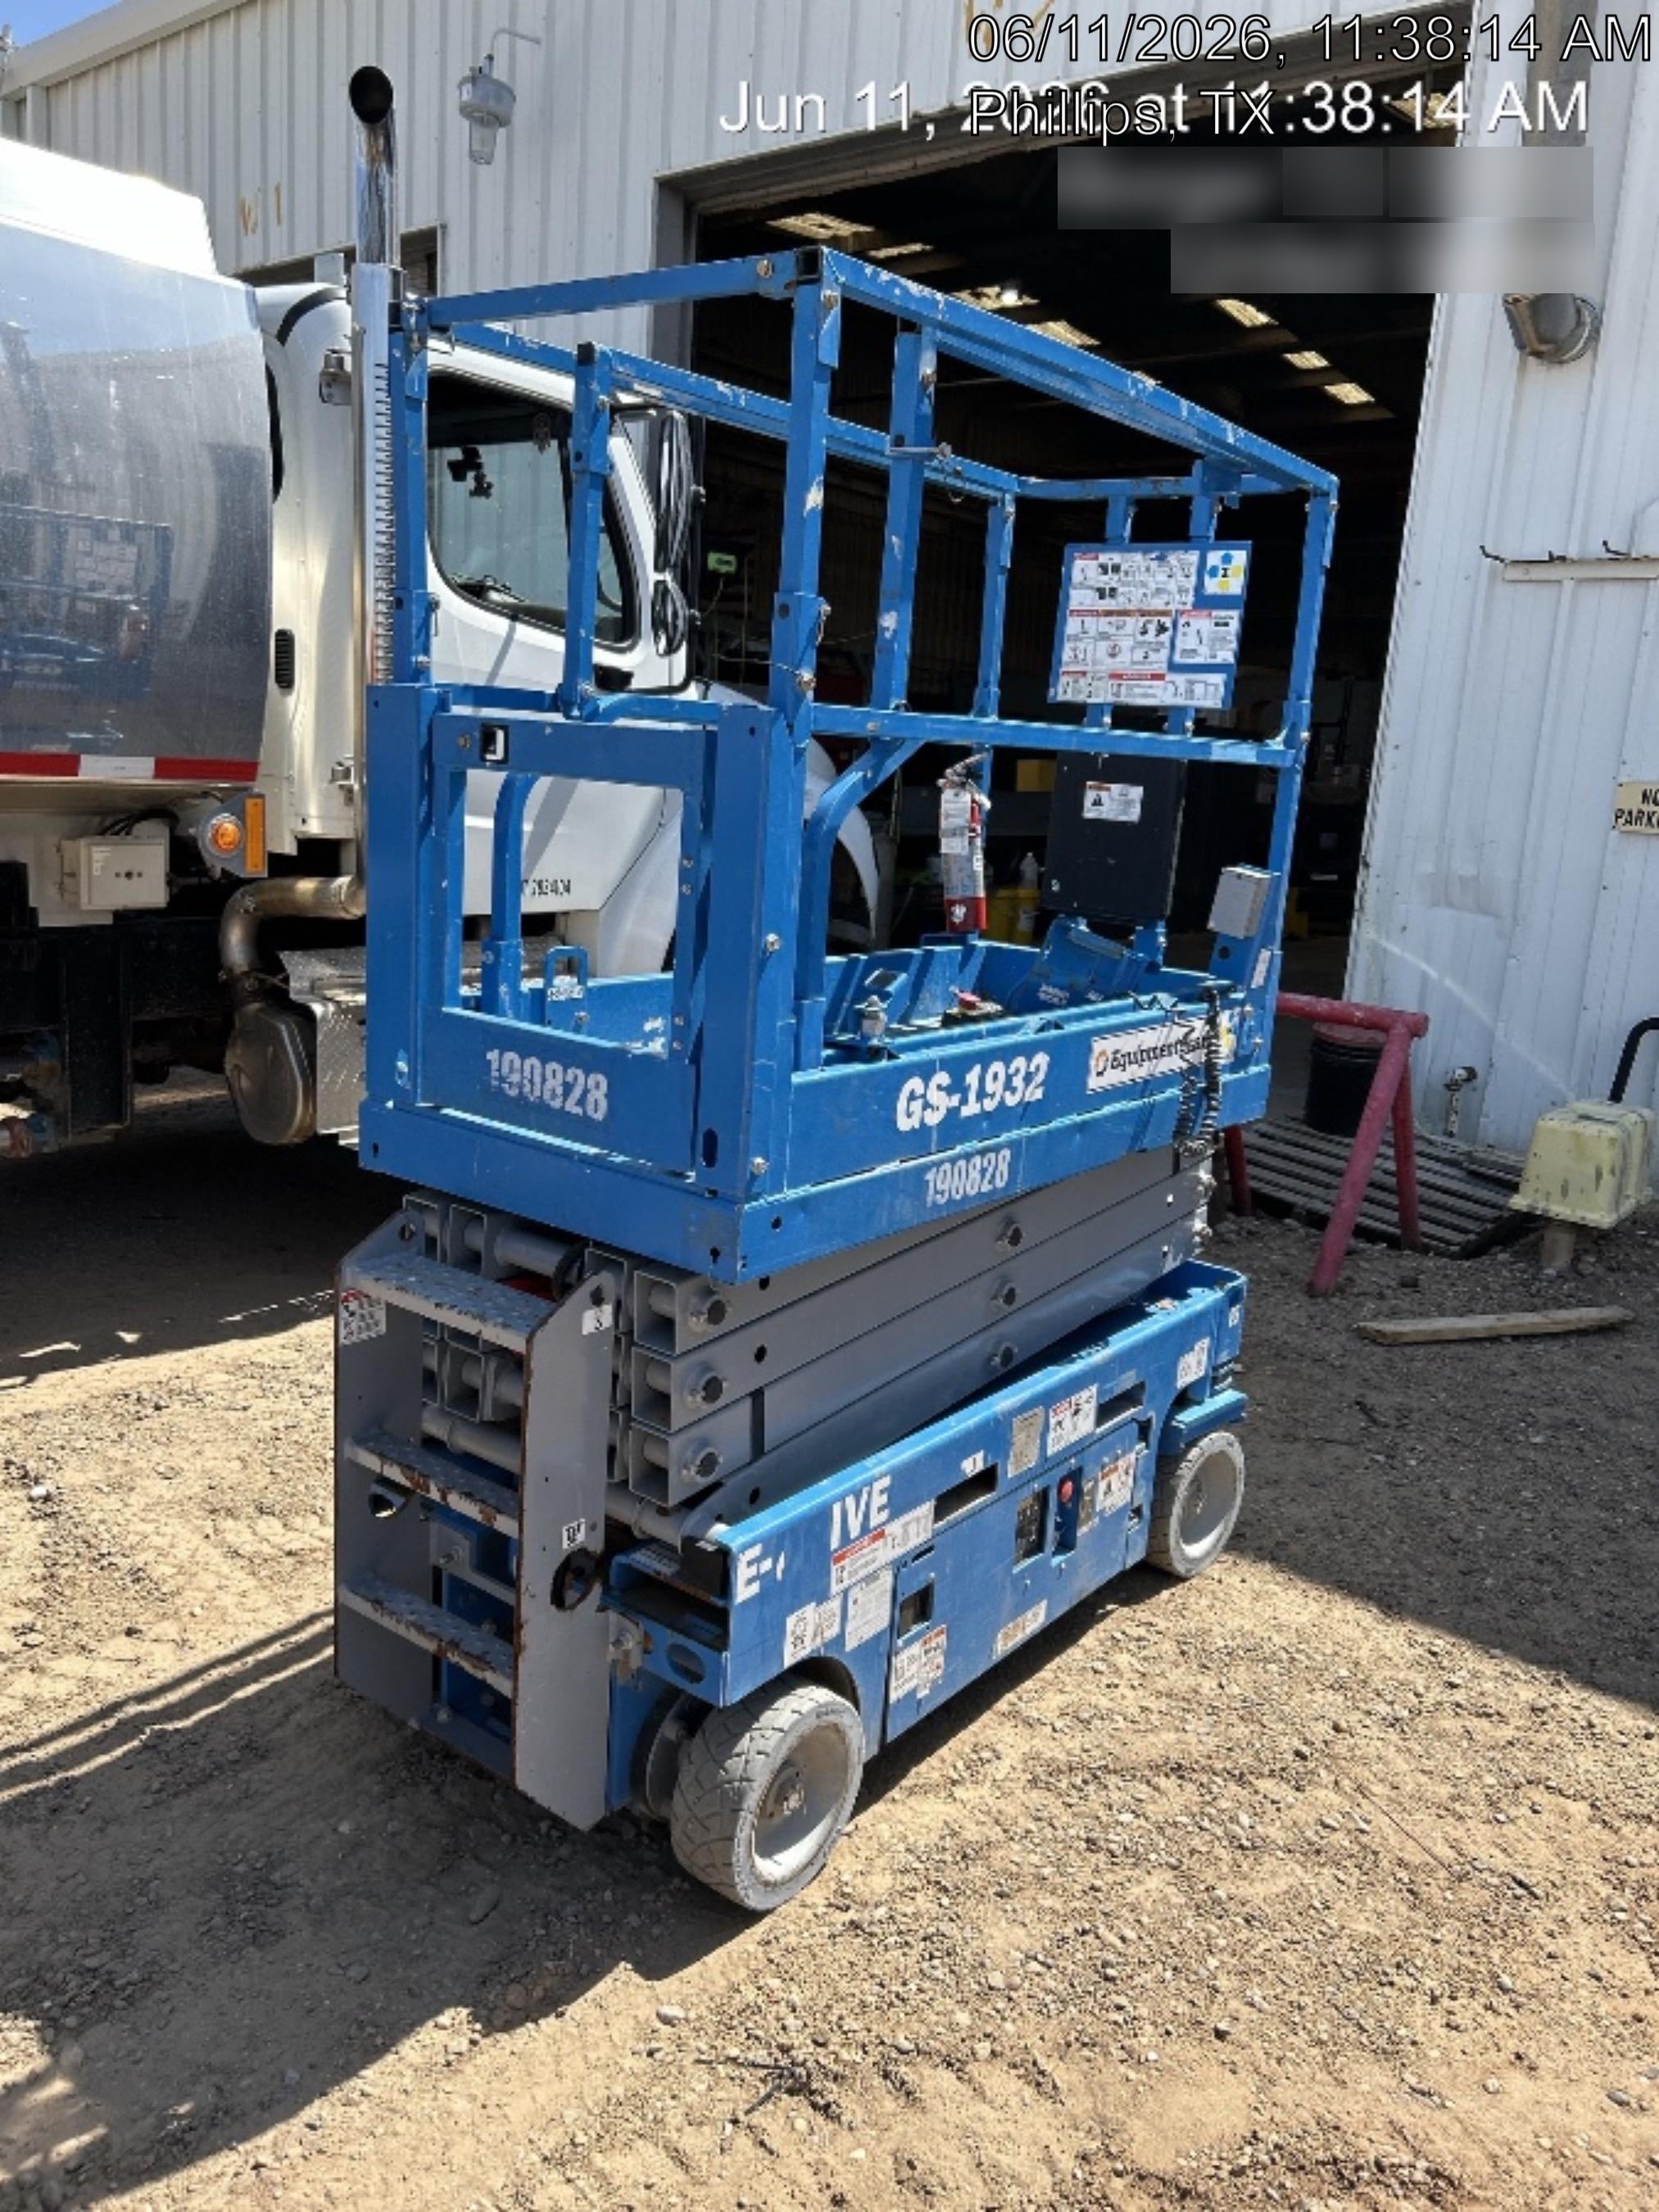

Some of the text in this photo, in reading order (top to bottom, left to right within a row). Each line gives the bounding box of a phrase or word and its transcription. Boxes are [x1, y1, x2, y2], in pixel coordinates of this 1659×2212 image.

[486, 1049, 608, 1122] 190828
[896, 1051, 1050, 1131] GS-1932
[924, 1148, 1012, 1208] 190828
